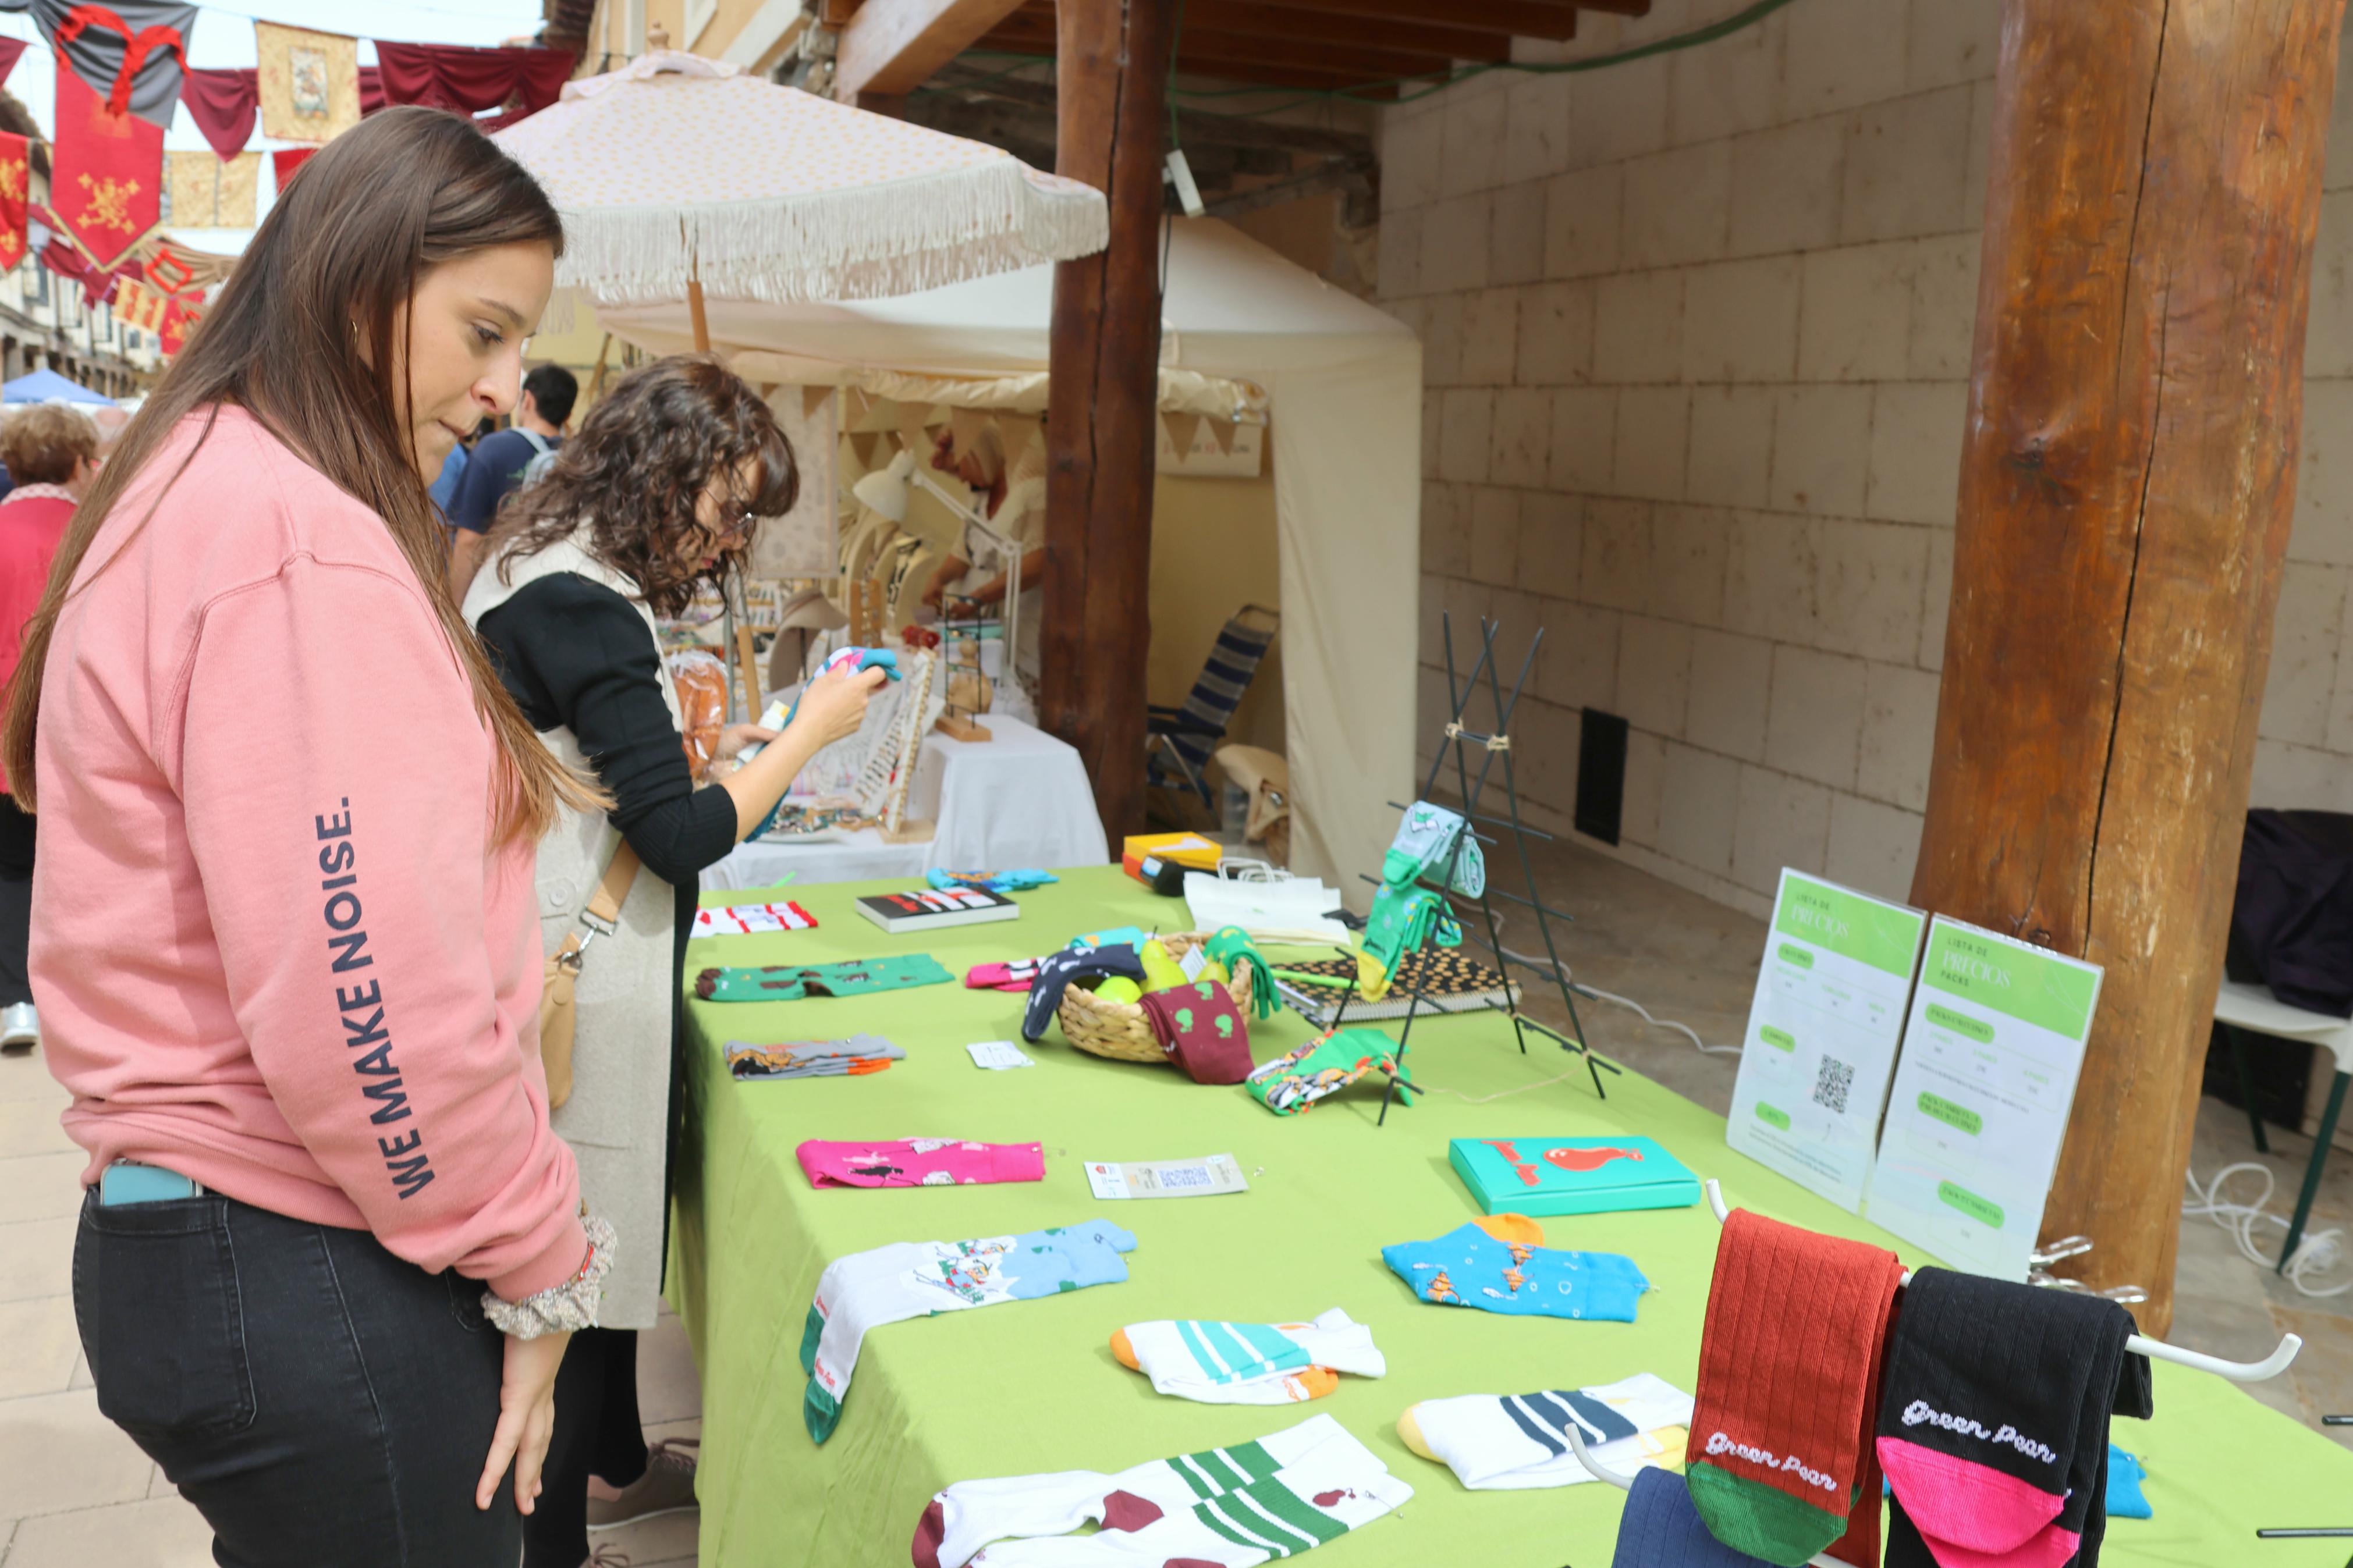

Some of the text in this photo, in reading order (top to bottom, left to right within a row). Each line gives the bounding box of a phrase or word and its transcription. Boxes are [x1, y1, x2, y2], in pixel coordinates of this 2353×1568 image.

[1790, 903, 1850, 938] PRECIOS
[1947, 937, 1988, 957] LISTA DE
[1940, 969, 1969, 987] PACKS
[1943, 949, 2012, 988] PRECIOS
[315, 797, 435, 1200] WE MAKE NOISE.
[1901, 1399, 2056, 1464] Green Pear
[1706, 1431, 1837, 1491] Green Pear
